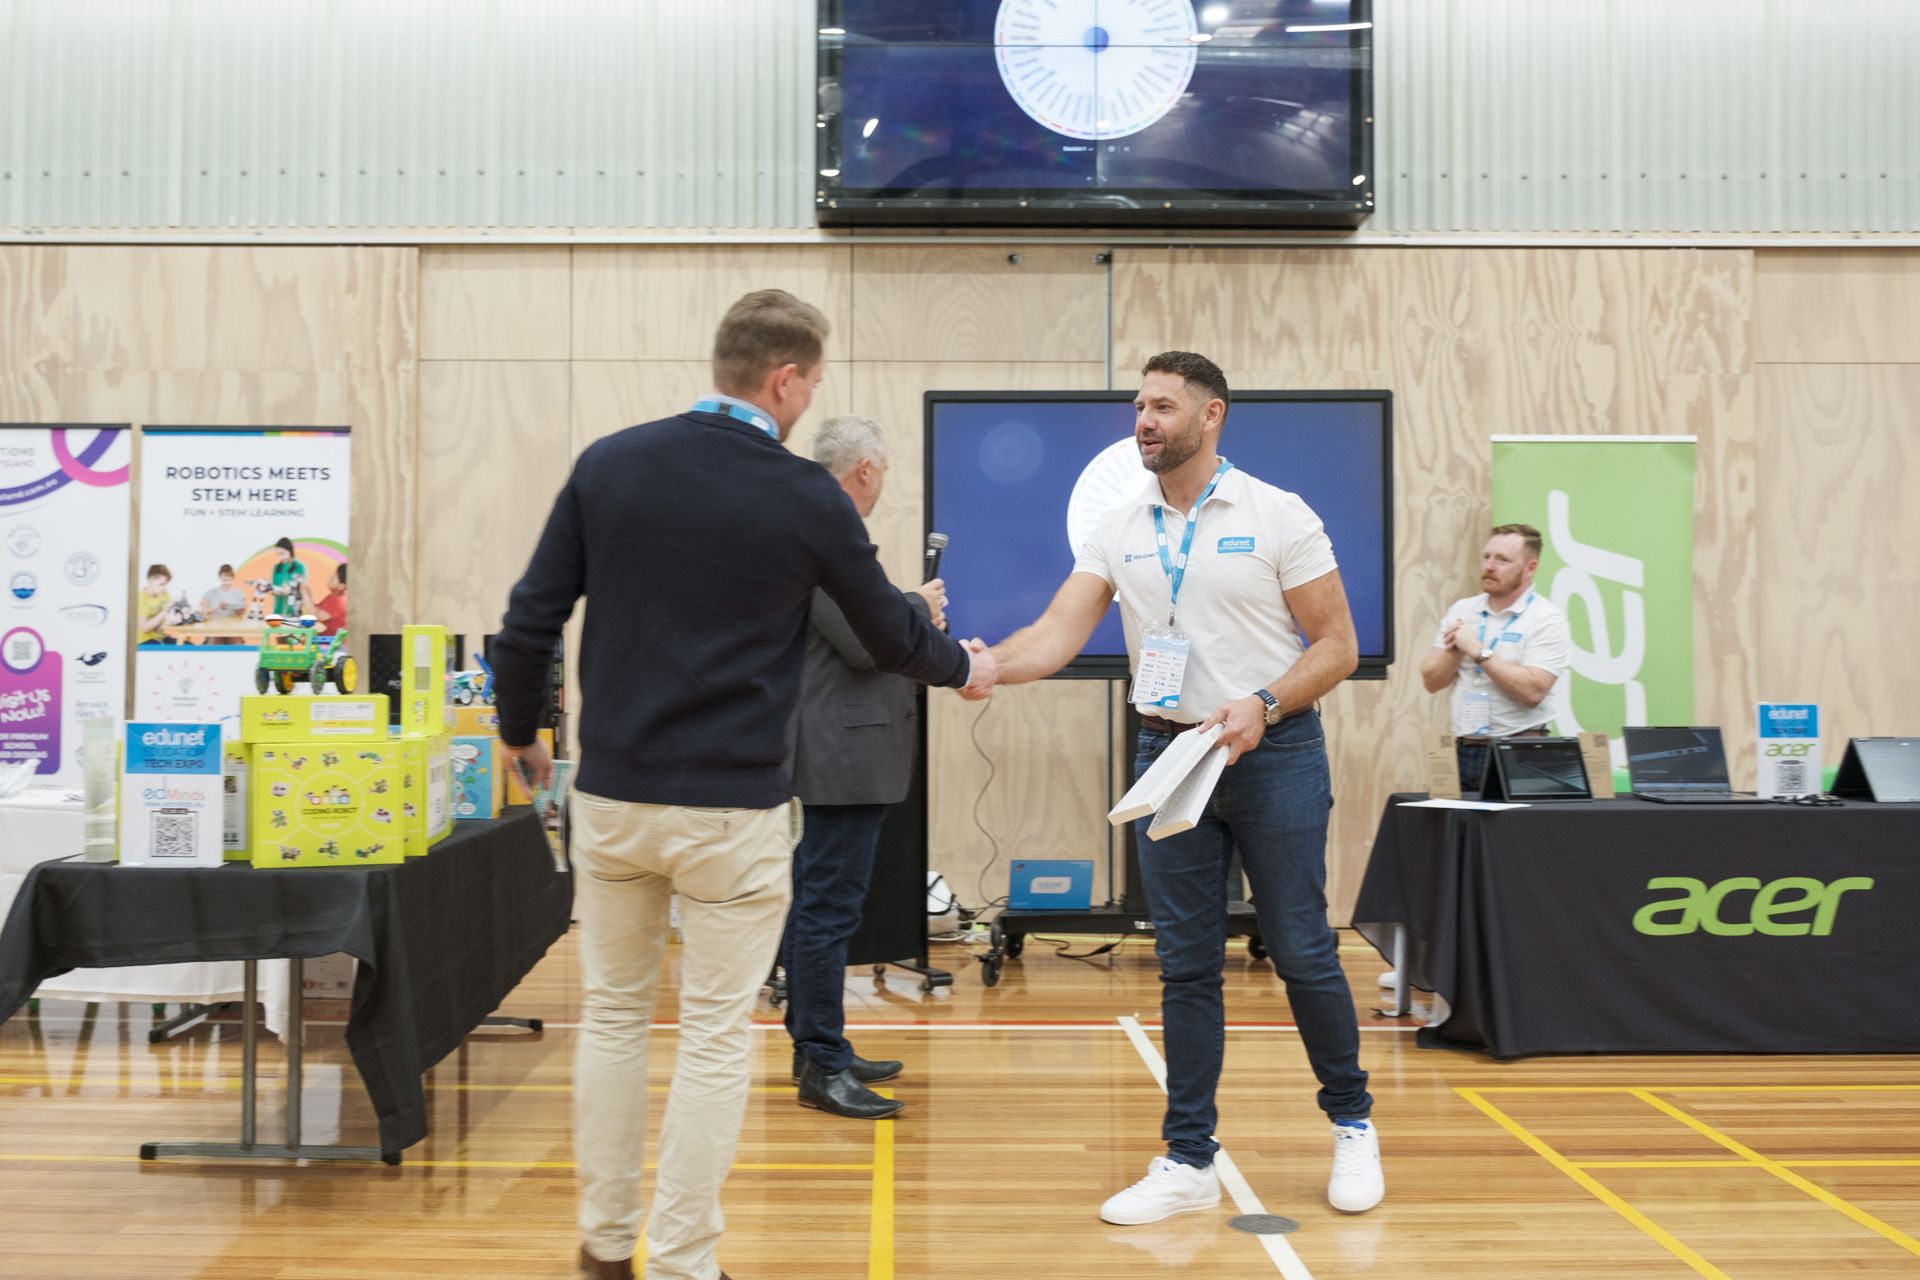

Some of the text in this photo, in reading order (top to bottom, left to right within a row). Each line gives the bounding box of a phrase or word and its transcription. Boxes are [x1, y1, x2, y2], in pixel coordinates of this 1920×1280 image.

[166, 466, 330, 480] ROBOTICS MEETS
[192, 488, 297, 501] STEM HERE
[218, 508, 247, 517] STEM
[250, 508, 305, 517] LEARNING
[1222, 539, 1250, 547] edunet
[1548, 489, 1648, 772] cer
[1768, 706, 1809, 720] edunet
[142, 728, 205, 746] edunet
[1764, 743, 1816, 757] acer
[144, 758, 205, 769] TECH EXPO
[1632, 876, 1875, 936] acer
